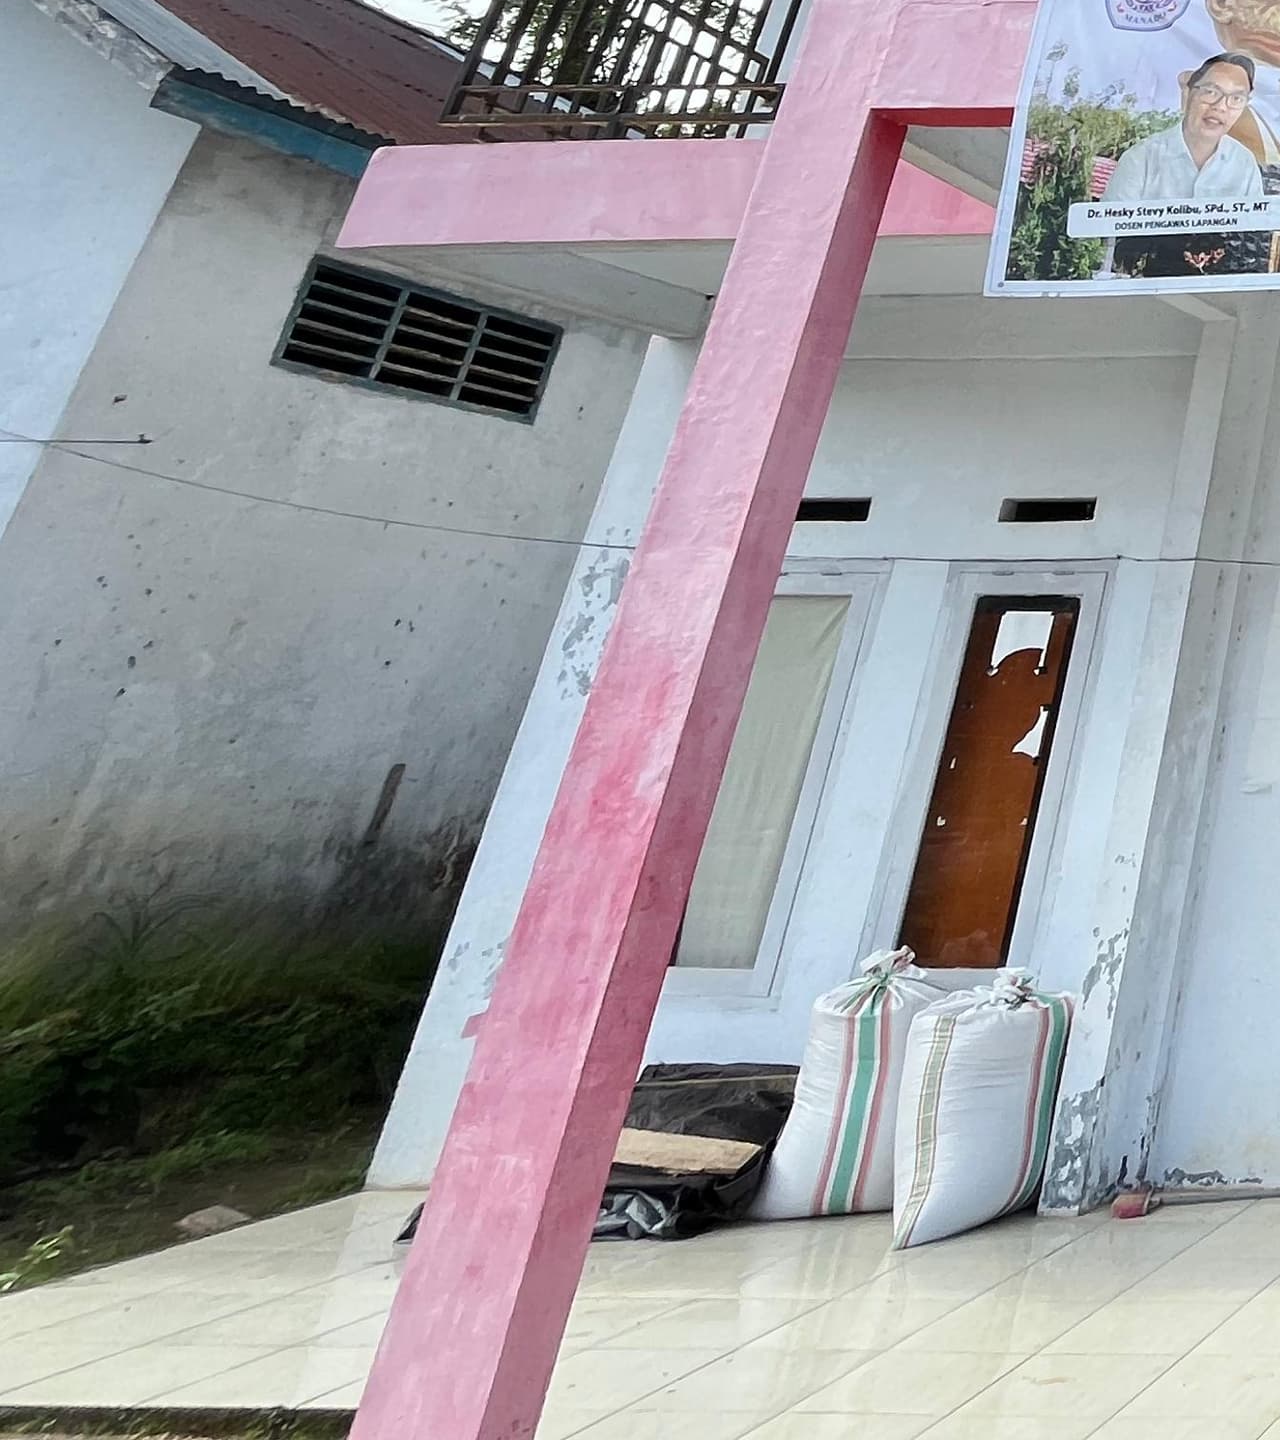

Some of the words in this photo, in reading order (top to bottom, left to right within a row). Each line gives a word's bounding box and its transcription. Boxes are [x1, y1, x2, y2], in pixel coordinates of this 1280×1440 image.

[1087, 209, 1103, 219] Dr.
[1104, 207, 1134, 220] Hesky
[1136, 206, 1164, 218] Stevy
[1252, 201, 1270, 212] MT
[1114, 221, 1143, 231] DOSEN
[1144, 219, 1190, 230] PENGAWAS
[1191, 218, 1238, 228] LAPANGAN
